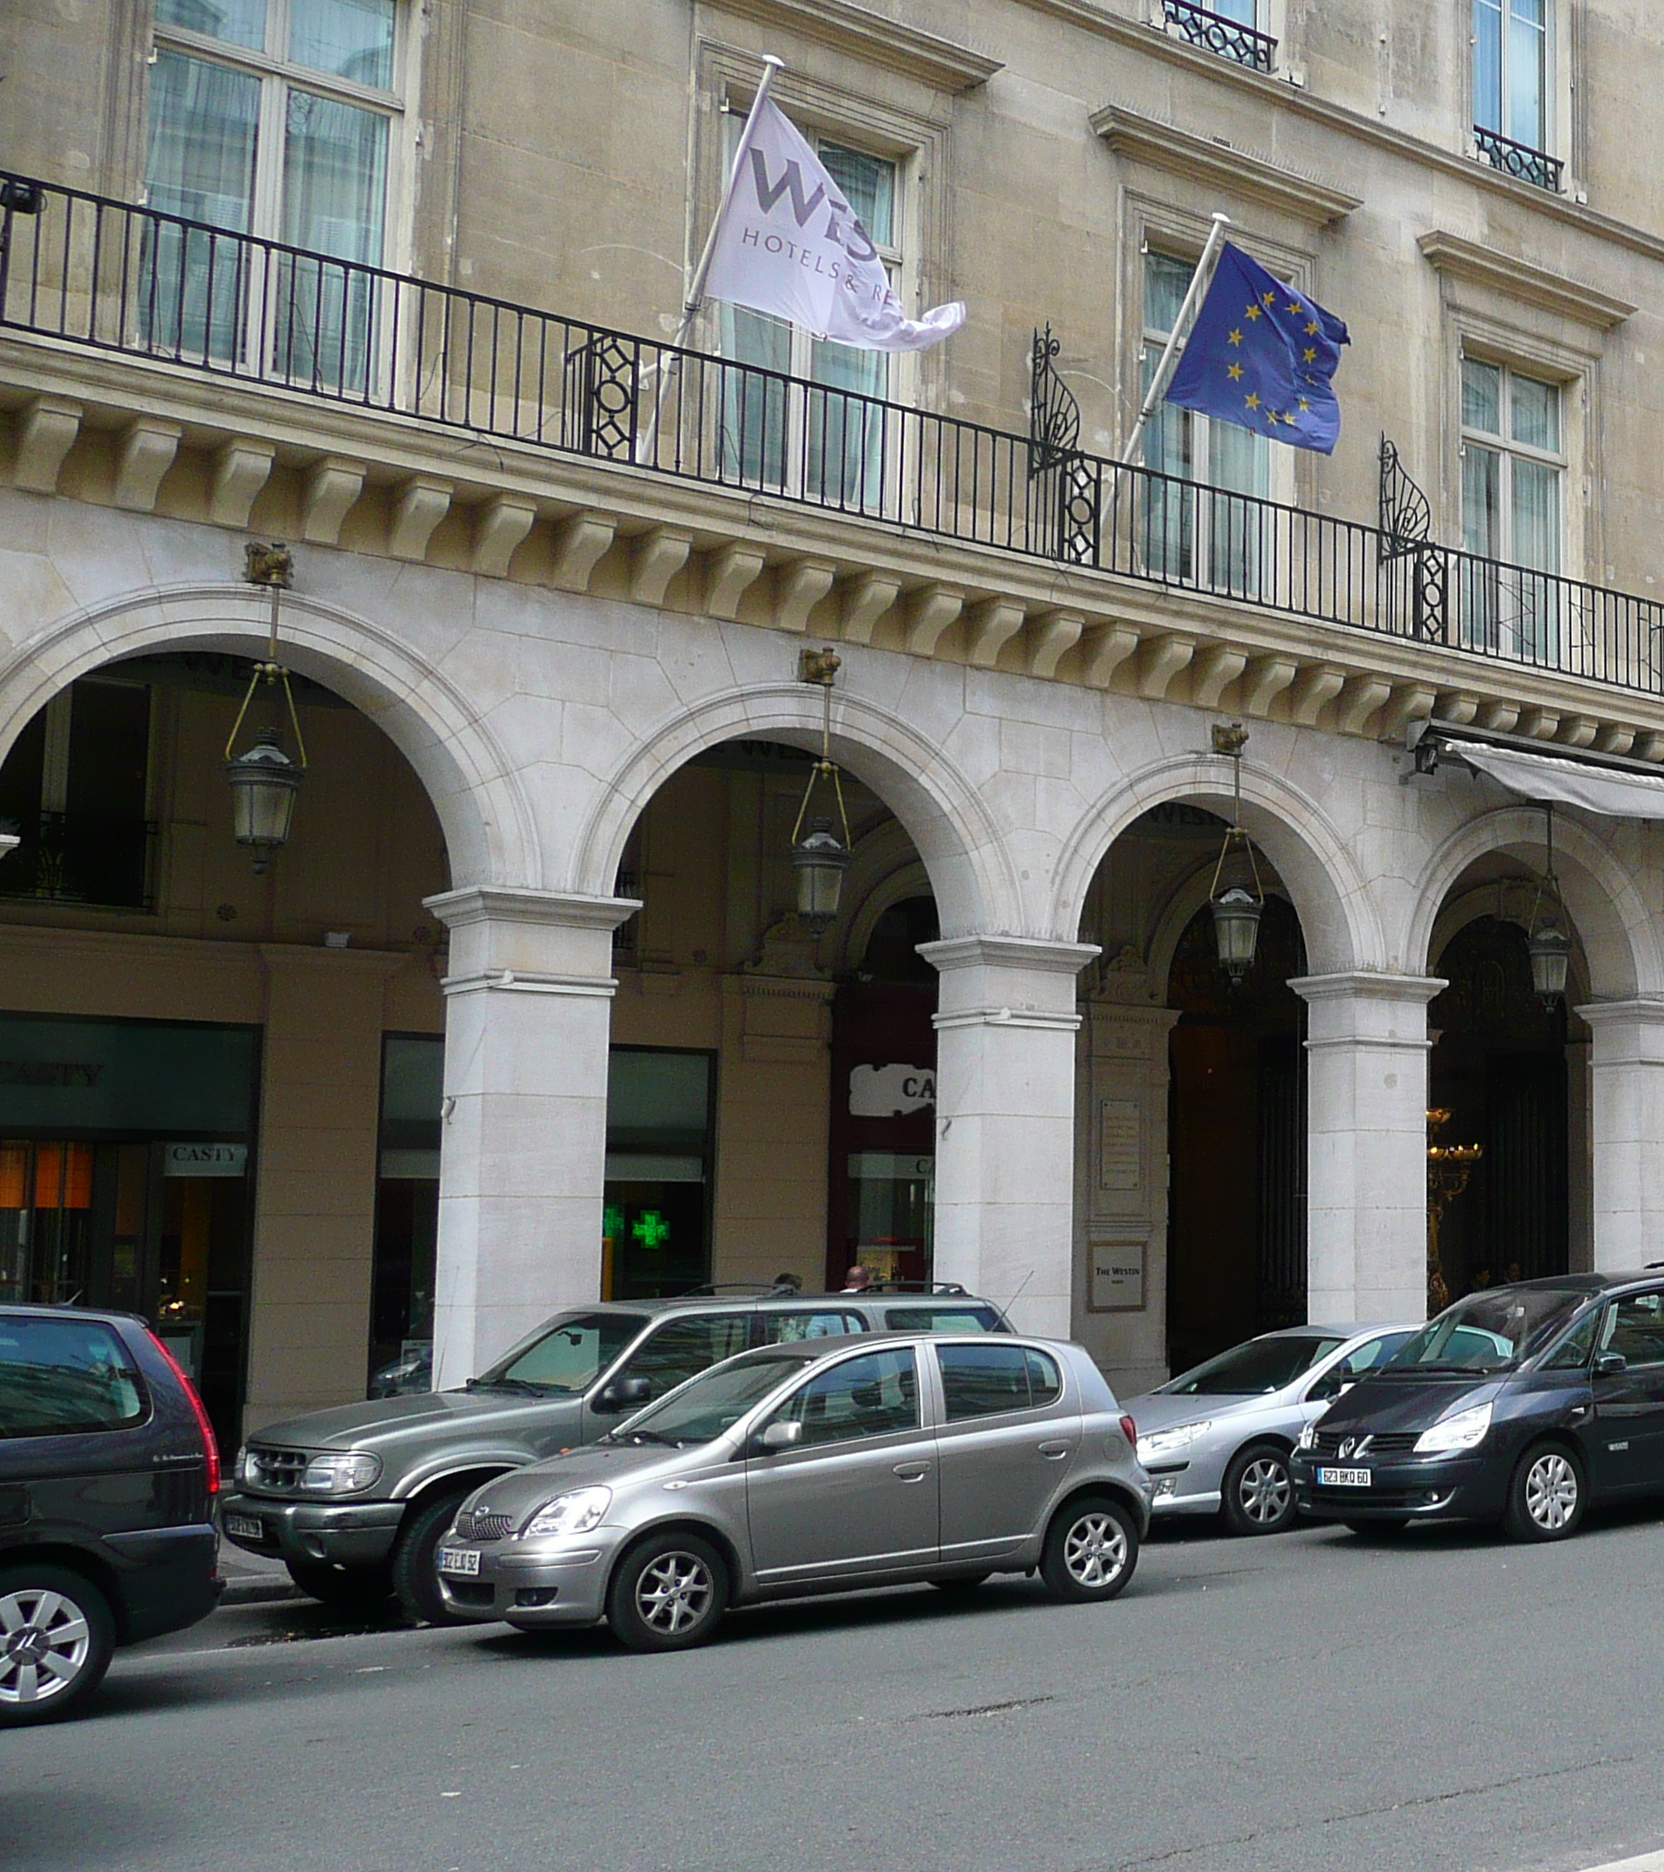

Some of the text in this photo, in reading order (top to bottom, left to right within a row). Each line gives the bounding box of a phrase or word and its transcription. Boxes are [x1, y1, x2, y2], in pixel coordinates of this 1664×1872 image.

[750, 147, 879, 262] WES
[742, 227, 897, 306] HOTELS & RE
[902, 1077, 937, 1099] CA
[173, 1146, 237, 1162] CASTY
[1324, 1470, 1337, 1483] 623
[1357, 1471, 1368, 1484] 60
